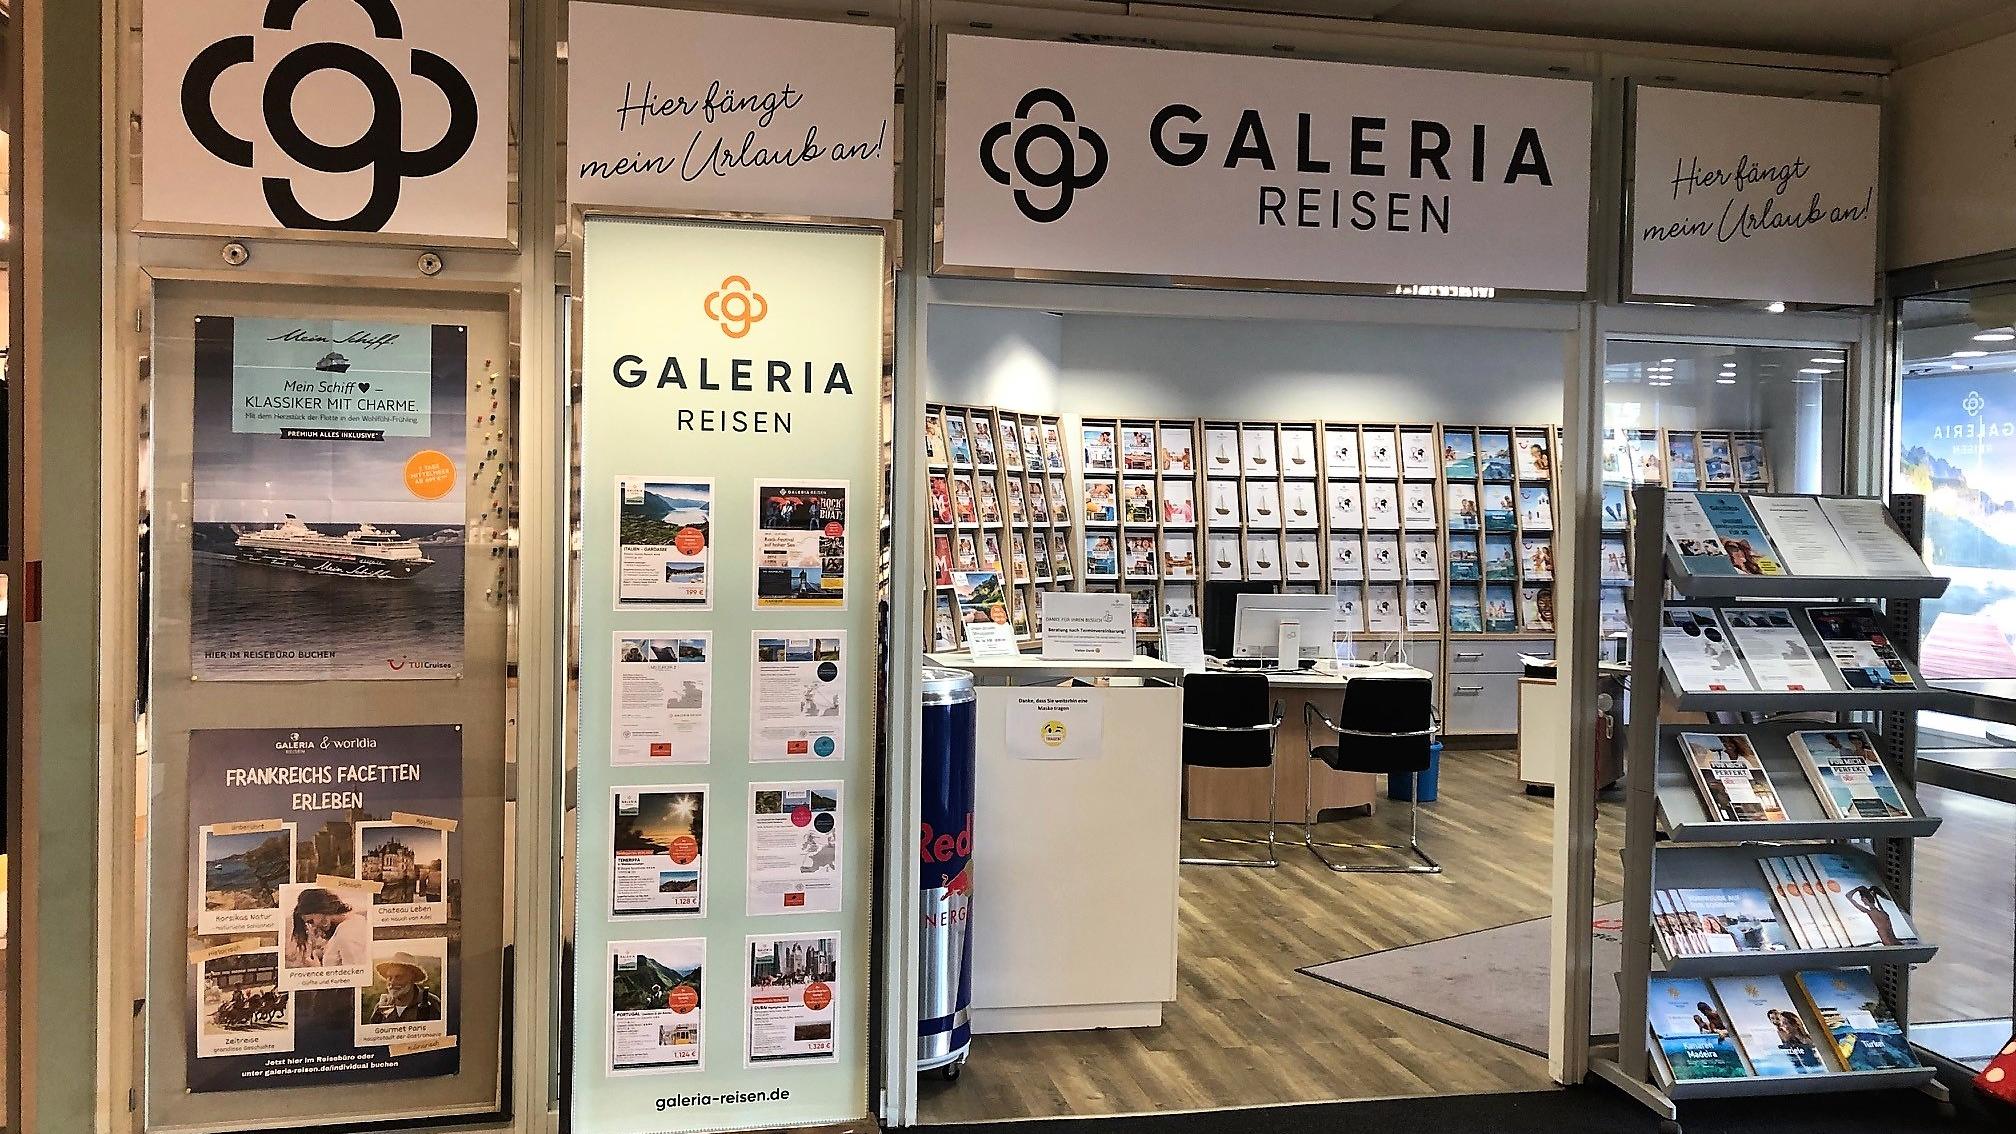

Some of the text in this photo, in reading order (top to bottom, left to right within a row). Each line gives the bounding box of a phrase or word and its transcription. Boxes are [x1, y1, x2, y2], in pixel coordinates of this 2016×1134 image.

[617, 80, 803, 131] Hier fängt
[580, 120, 887, 182] mein Urlaub an!
[1149, 103, 1554, 187] GALERIA
[1671, 154, 1810, 200] Hier fängt
[1259, 186, 1451, 235] REISEN
[1643, 186, 1874, 242] mein Urlaub an!
[267, 328, 330, 342] Mein
[612, 354, 854, 395] GALERIA
[283, 380, 358, 396] Mein Schiff
[245, 396, 419, 412] KLASSIKER MIT CHARME.
[677, 409, 792, 434] REISEN
[204, 650, 336, 659] HIER IM REISEBÜRO BUCHEN
[275, 735, 377, 750] GALERIA & worldia
[225, 763, 421, 788] FRANKREICHS FACETTEN
[292, 792, 363, 811] ERLEBEN
[920, 812, 972, 864] Red
[250, 913, 272, 921] Natur
[410, 905, 432, 913] Leben
[290, 967, 364, 978] Provence entdecken
[374, 1024, 427, 1034] Gourmet Paris
[225, 1037, 259, 1045] Zeitreise
[264, 1058, 286, 1066] Jetzt
[287, 1057, 303, 1065] hier
[316, 1054, 356, 1063] Reisebüro
[1686, 1050, 1719, 1059] Madeira
[370, 1060, 399, 1069] buchen
[655, 1087, 790, 1112] galeria-reisen.de
